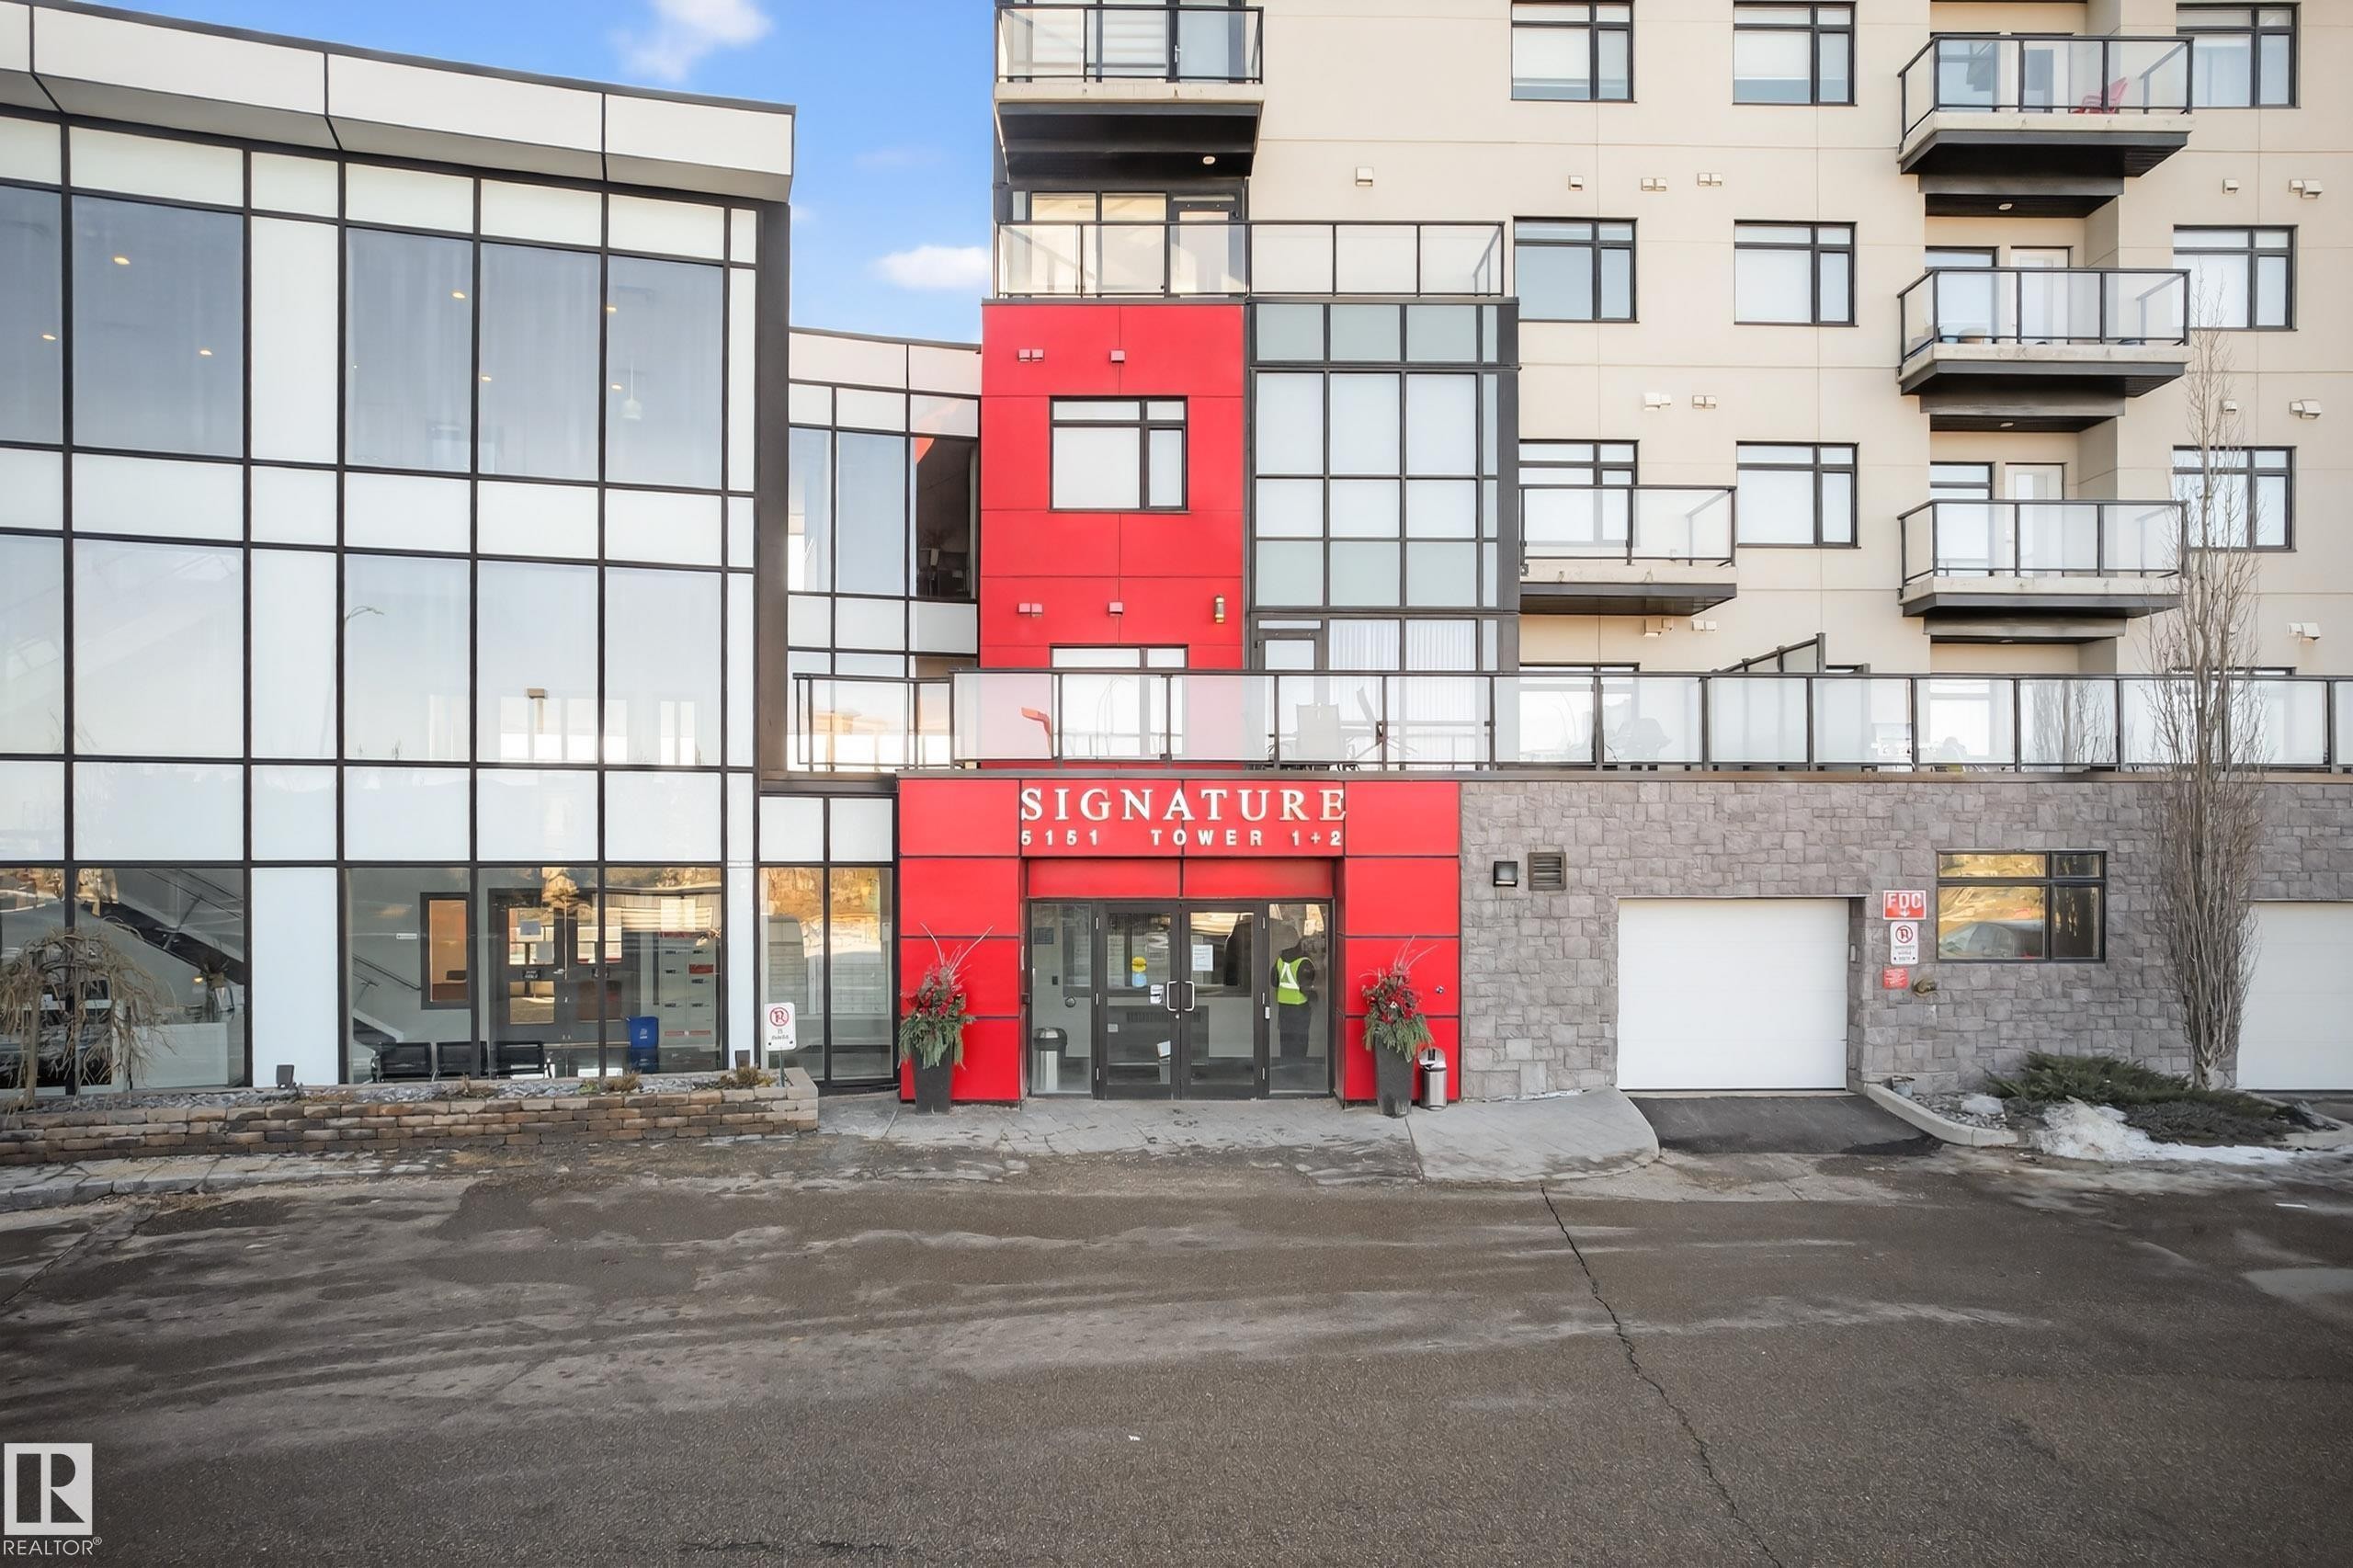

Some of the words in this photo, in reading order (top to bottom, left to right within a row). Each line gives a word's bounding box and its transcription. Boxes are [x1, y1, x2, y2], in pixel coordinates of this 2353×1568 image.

[1021, 788, 1347, 822] SIGNATURE
[1021, 829, 1098, 846] 5151
[1151, 829, 1263, 846] TOWER
[1291, 830, 1342, 846] 1+2
[1887, 892, 1922, 909] FDC
